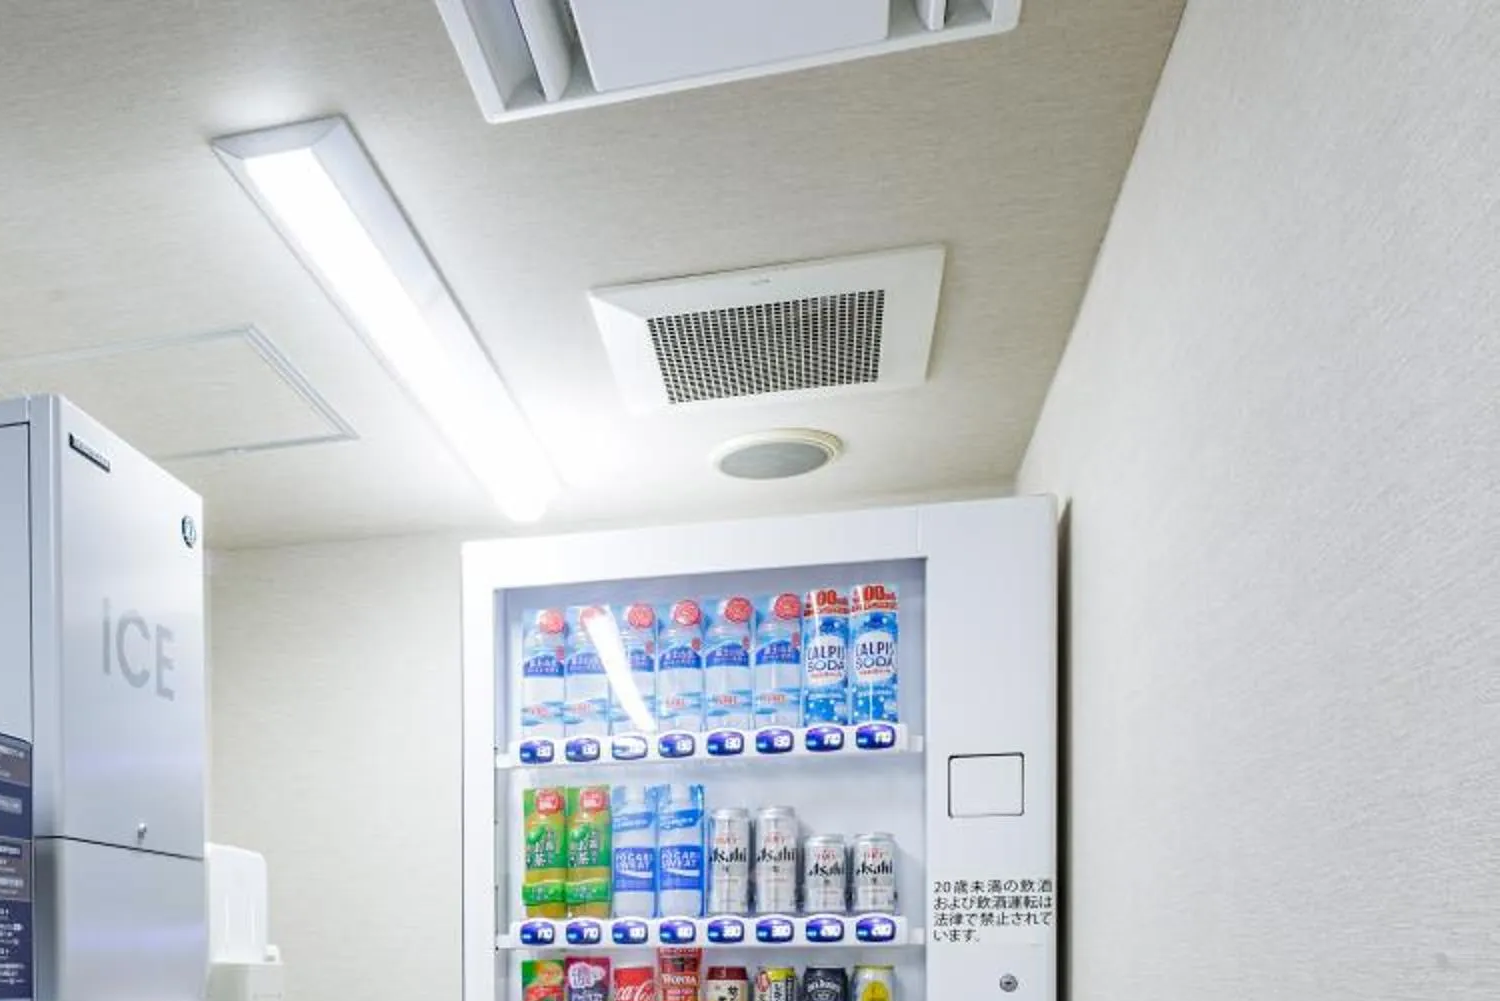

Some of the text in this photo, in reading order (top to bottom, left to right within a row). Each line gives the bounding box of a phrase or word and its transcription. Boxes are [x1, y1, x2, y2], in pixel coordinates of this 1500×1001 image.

[103, 598, 175, 701] ICE
[709, 847, 747, 863] Asahi
[757, 847, 795, 862] Asahi
[809, 861, 845, 877] Asahi
[856, 860, 893, 875] Asahi
[933, 880, 1053, 894] 20歳未満の飲酒
[933, 896, 1053, 910] および飲酒運転は
[933, 912, 1053, 926] 法律で禁止されて
[933, 929, 980, 943] います。
